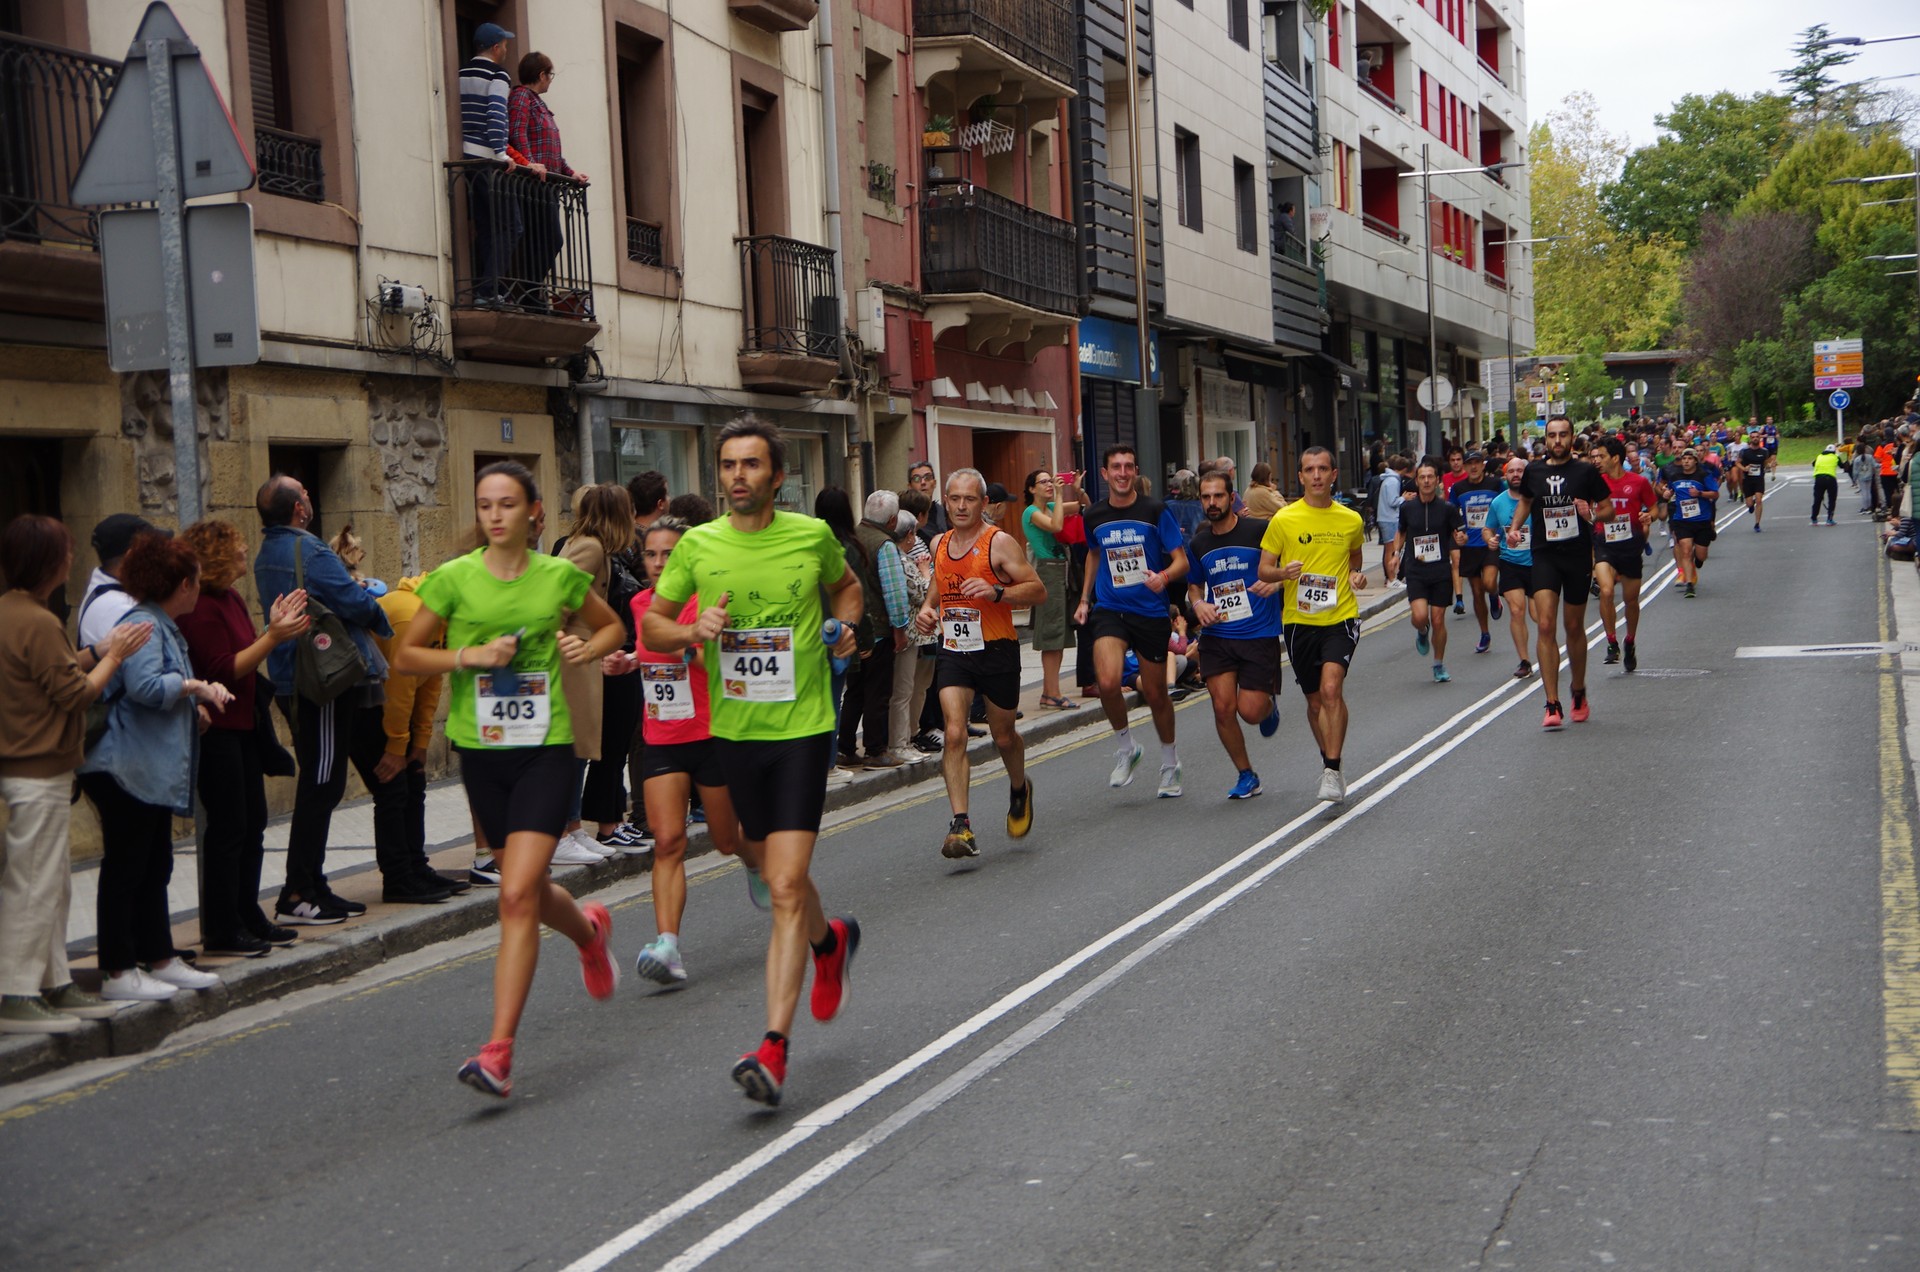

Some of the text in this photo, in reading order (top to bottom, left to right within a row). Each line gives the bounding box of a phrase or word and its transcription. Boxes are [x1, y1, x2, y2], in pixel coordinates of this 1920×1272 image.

[503, 422, 511, 439] 12
[1555, 518, 1568, 529] 19
[1610, 524, 1627, 533] 144
[1420, 544, 1435, 553] 748
[1116, 559, 1139, 573] 632
[1305, 589, 1328, 601] 455
[1220, 596, 1242, 610] 262
[954, 623, 970, 637] 94
[734, 656, 779, 676] 404
[654, 684, 675, 701] 99
[492, 700, 535, 720] 403
